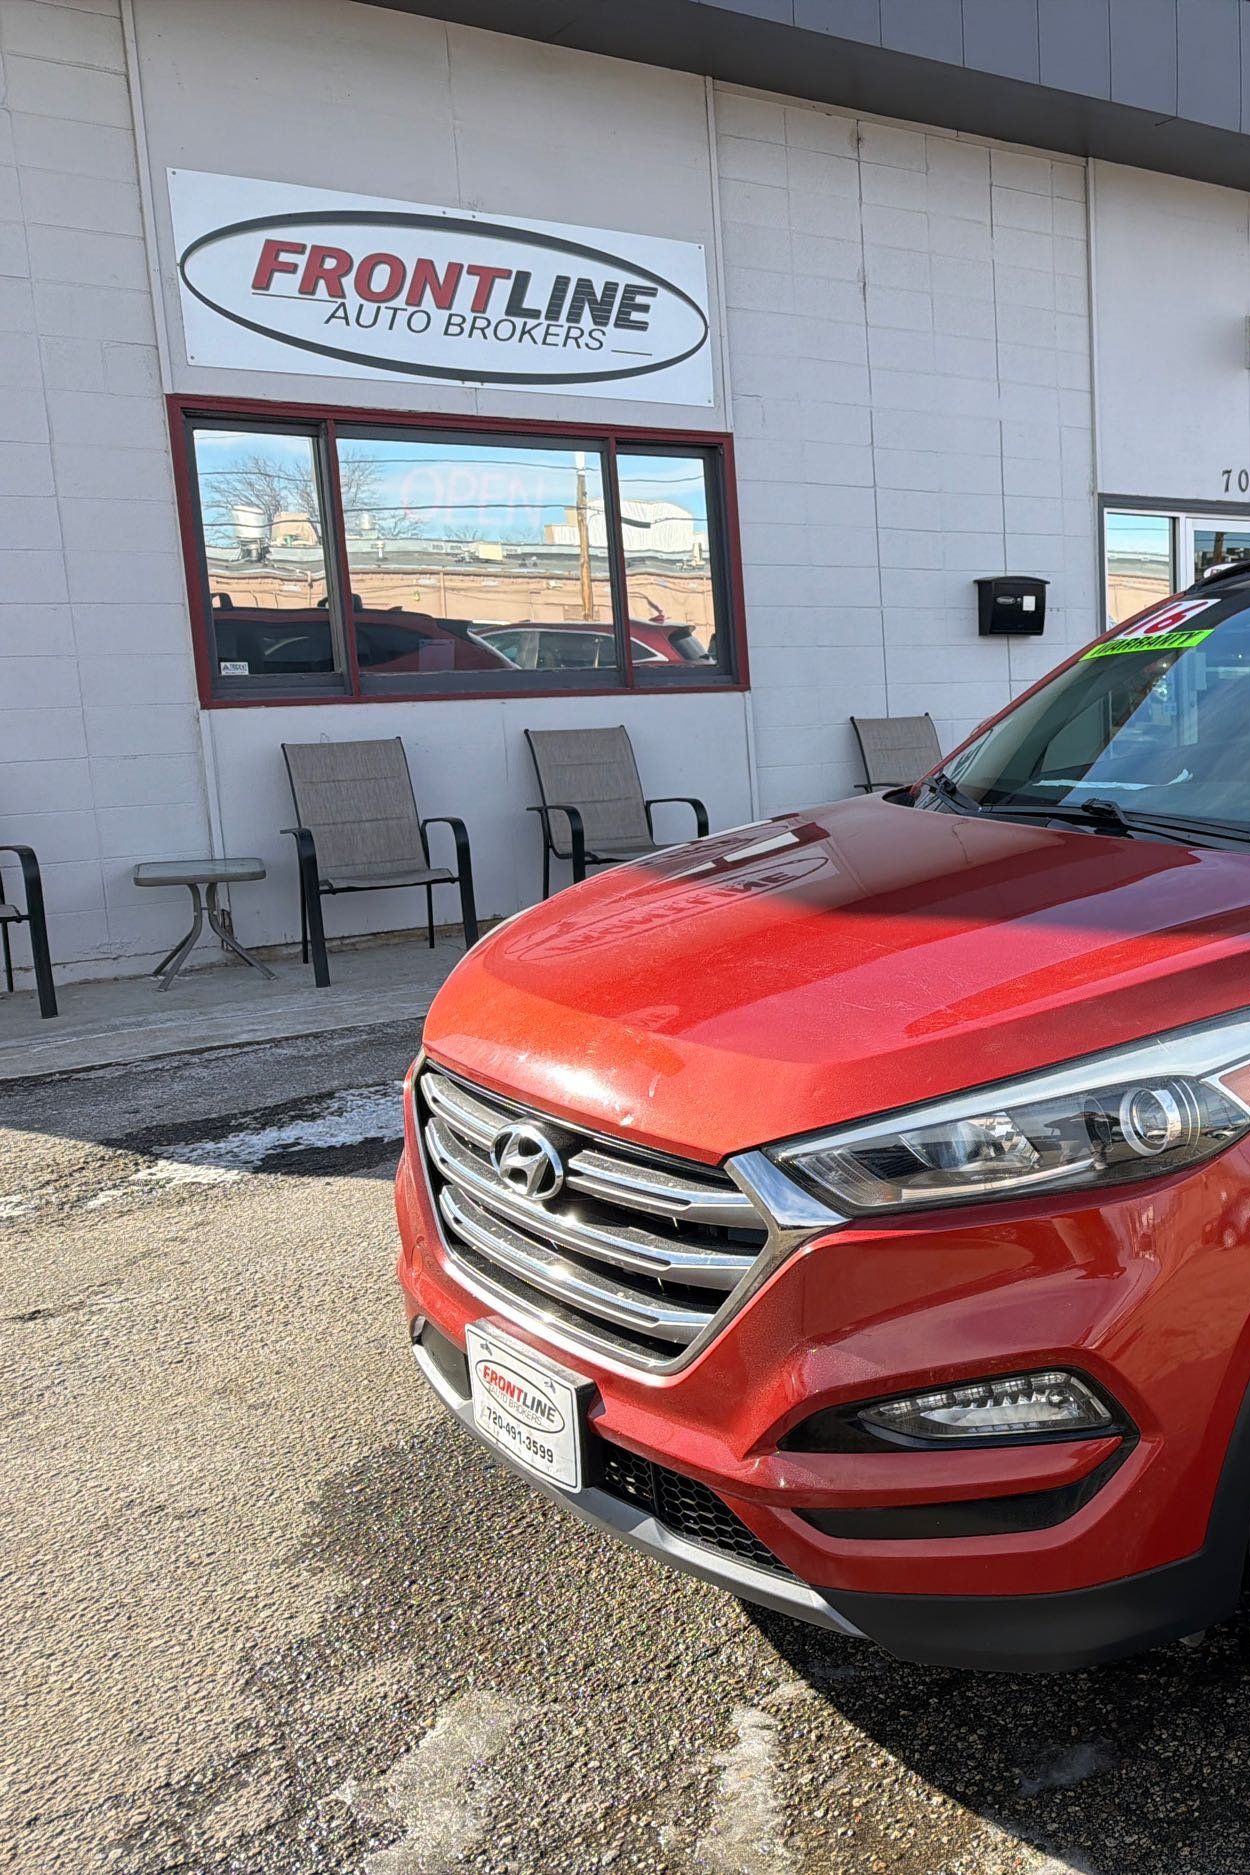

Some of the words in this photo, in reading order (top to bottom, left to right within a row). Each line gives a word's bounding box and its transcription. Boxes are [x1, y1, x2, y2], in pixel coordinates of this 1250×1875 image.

[252, 238, 659, 333] FRONTLINE
[324, 301, 433, 335] AUTO
[443, 316, 607, 352] BROKERS
[401, 466, 545, 526] OPEN
[1090, 631, 1204, 657] WARRANTY
[482, 1365, 557, 1424] FRONTLINE
[488, 1386, 508, 1405] AUTO
[508, 1397, 543, 1426] BROKERS
[485, 1406, 554, 1464] 720-491-3599
